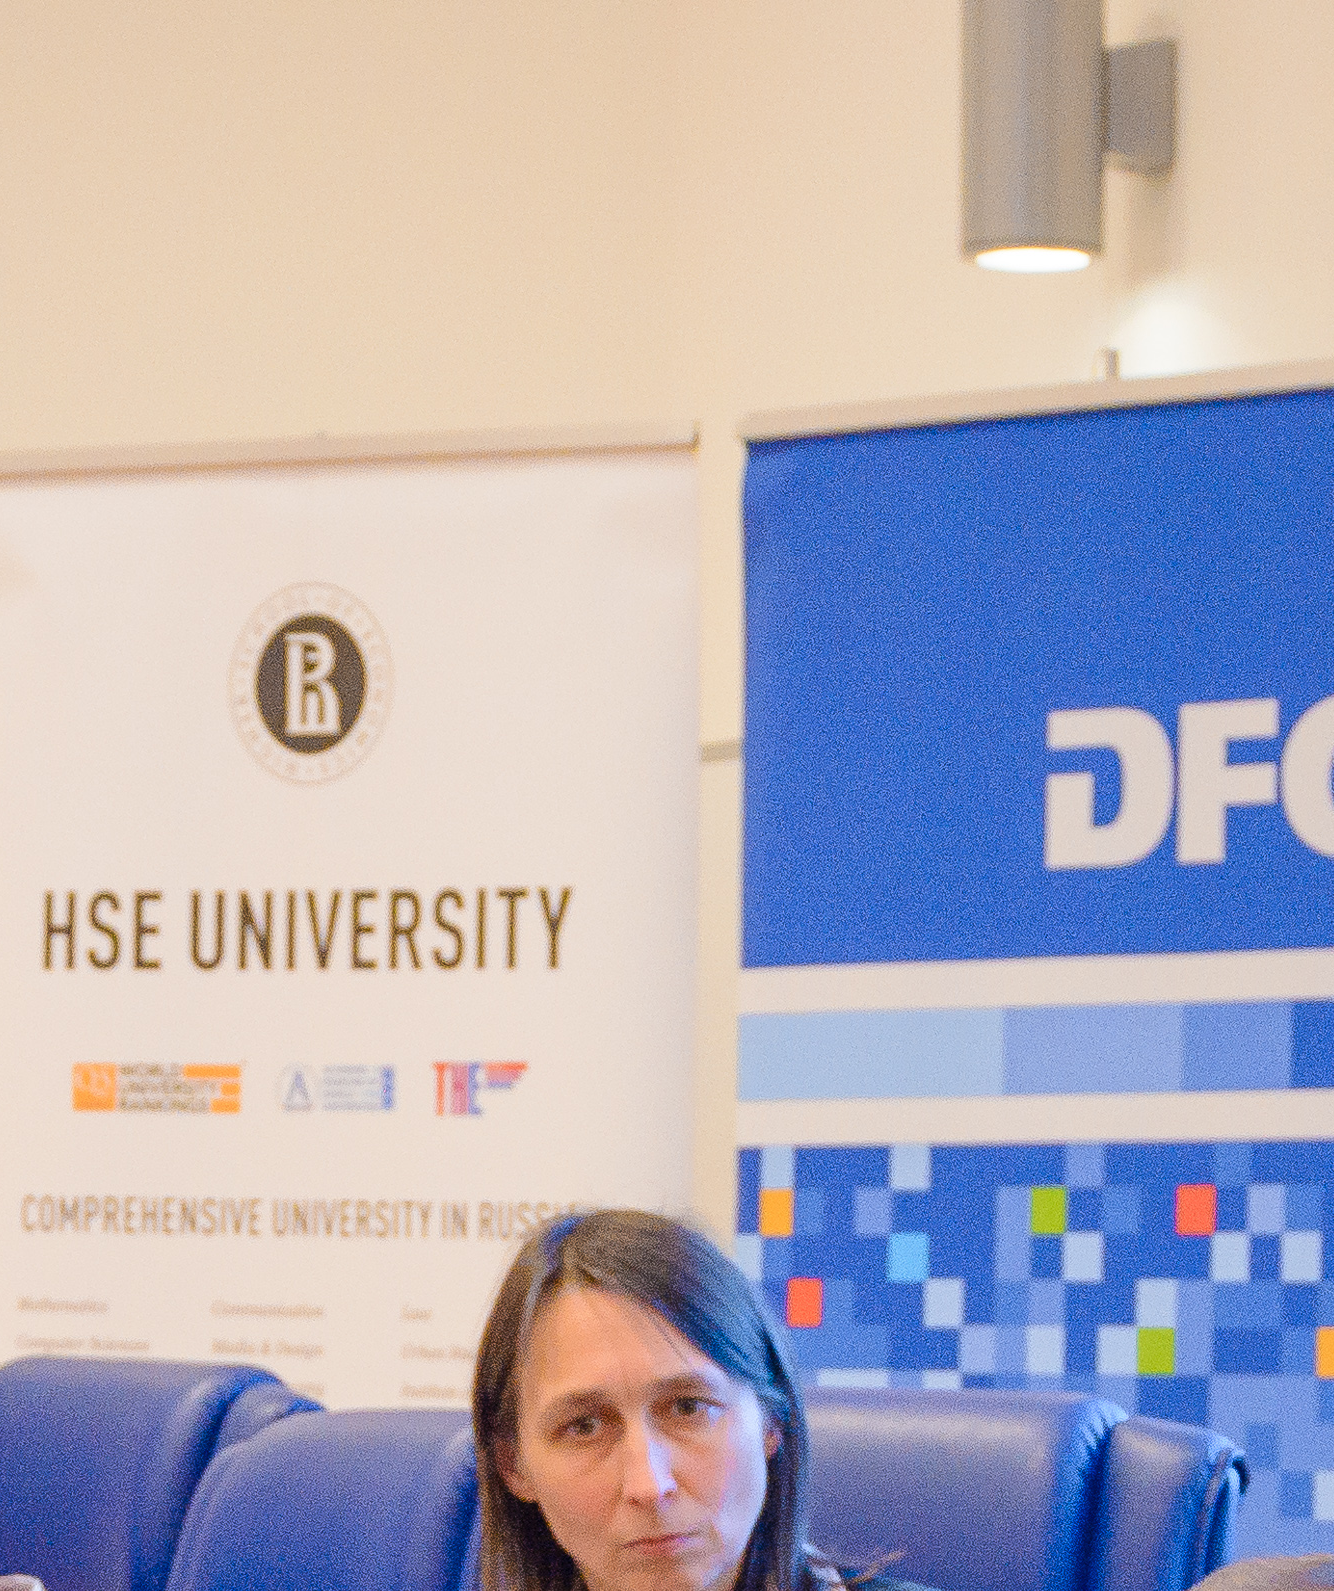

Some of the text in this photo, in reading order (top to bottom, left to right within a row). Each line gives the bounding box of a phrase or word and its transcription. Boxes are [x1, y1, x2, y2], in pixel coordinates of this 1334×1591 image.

[41, 887, 575, 972] HSE UNIVERSITY
[20, 1193, 577, 1242] COMPREHENSIVE UNIVERSITY IN RUSS
